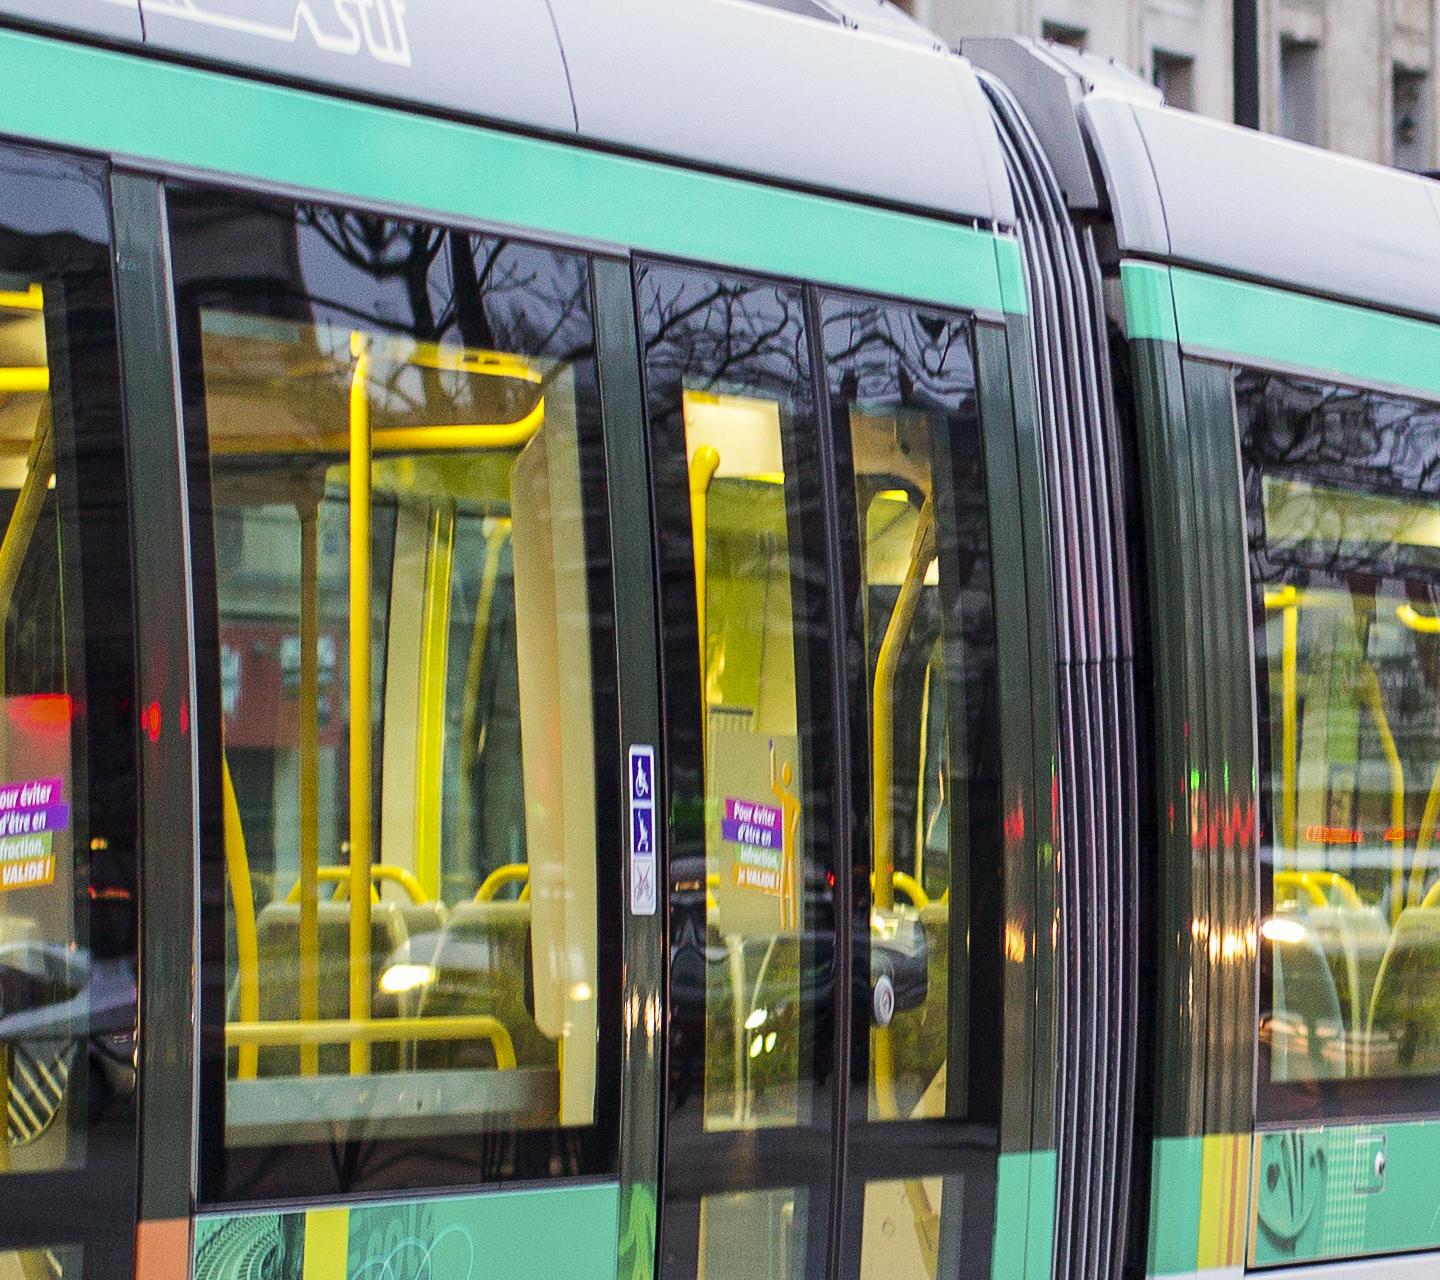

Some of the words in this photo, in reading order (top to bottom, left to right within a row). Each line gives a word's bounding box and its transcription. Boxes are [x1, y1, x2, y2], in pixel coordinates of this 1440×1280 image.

[20, 782, 52, 807] éviter
[32, 811, 47, 831] en
[2, 860, 45, 885] VALIDE
